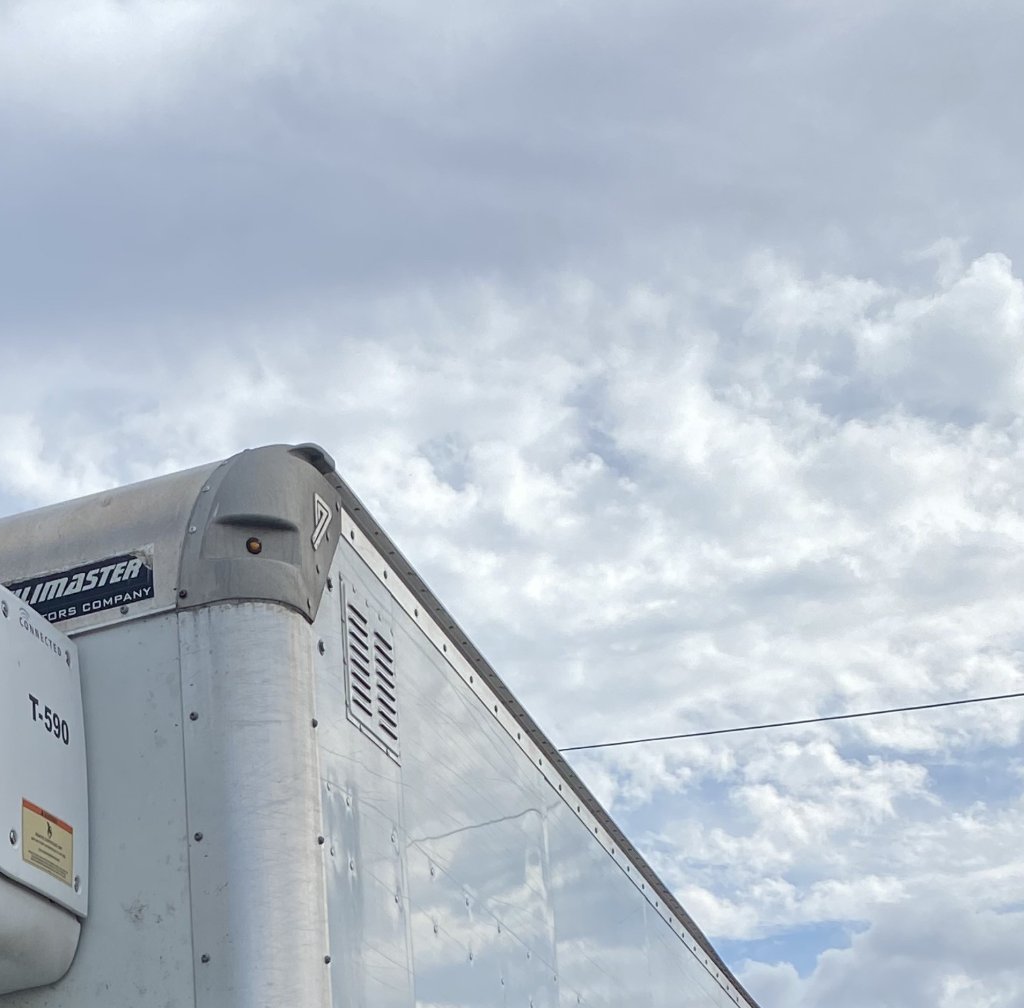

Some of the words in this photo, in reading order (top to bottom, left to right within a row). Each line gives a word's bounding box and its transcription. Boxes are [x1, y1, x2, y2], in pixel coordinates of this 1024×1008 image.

[82, 586, 152, 613] COMPANY
[19, 616, 62, 657] CONNECTED
[28, 693, 70, 746] T-590
